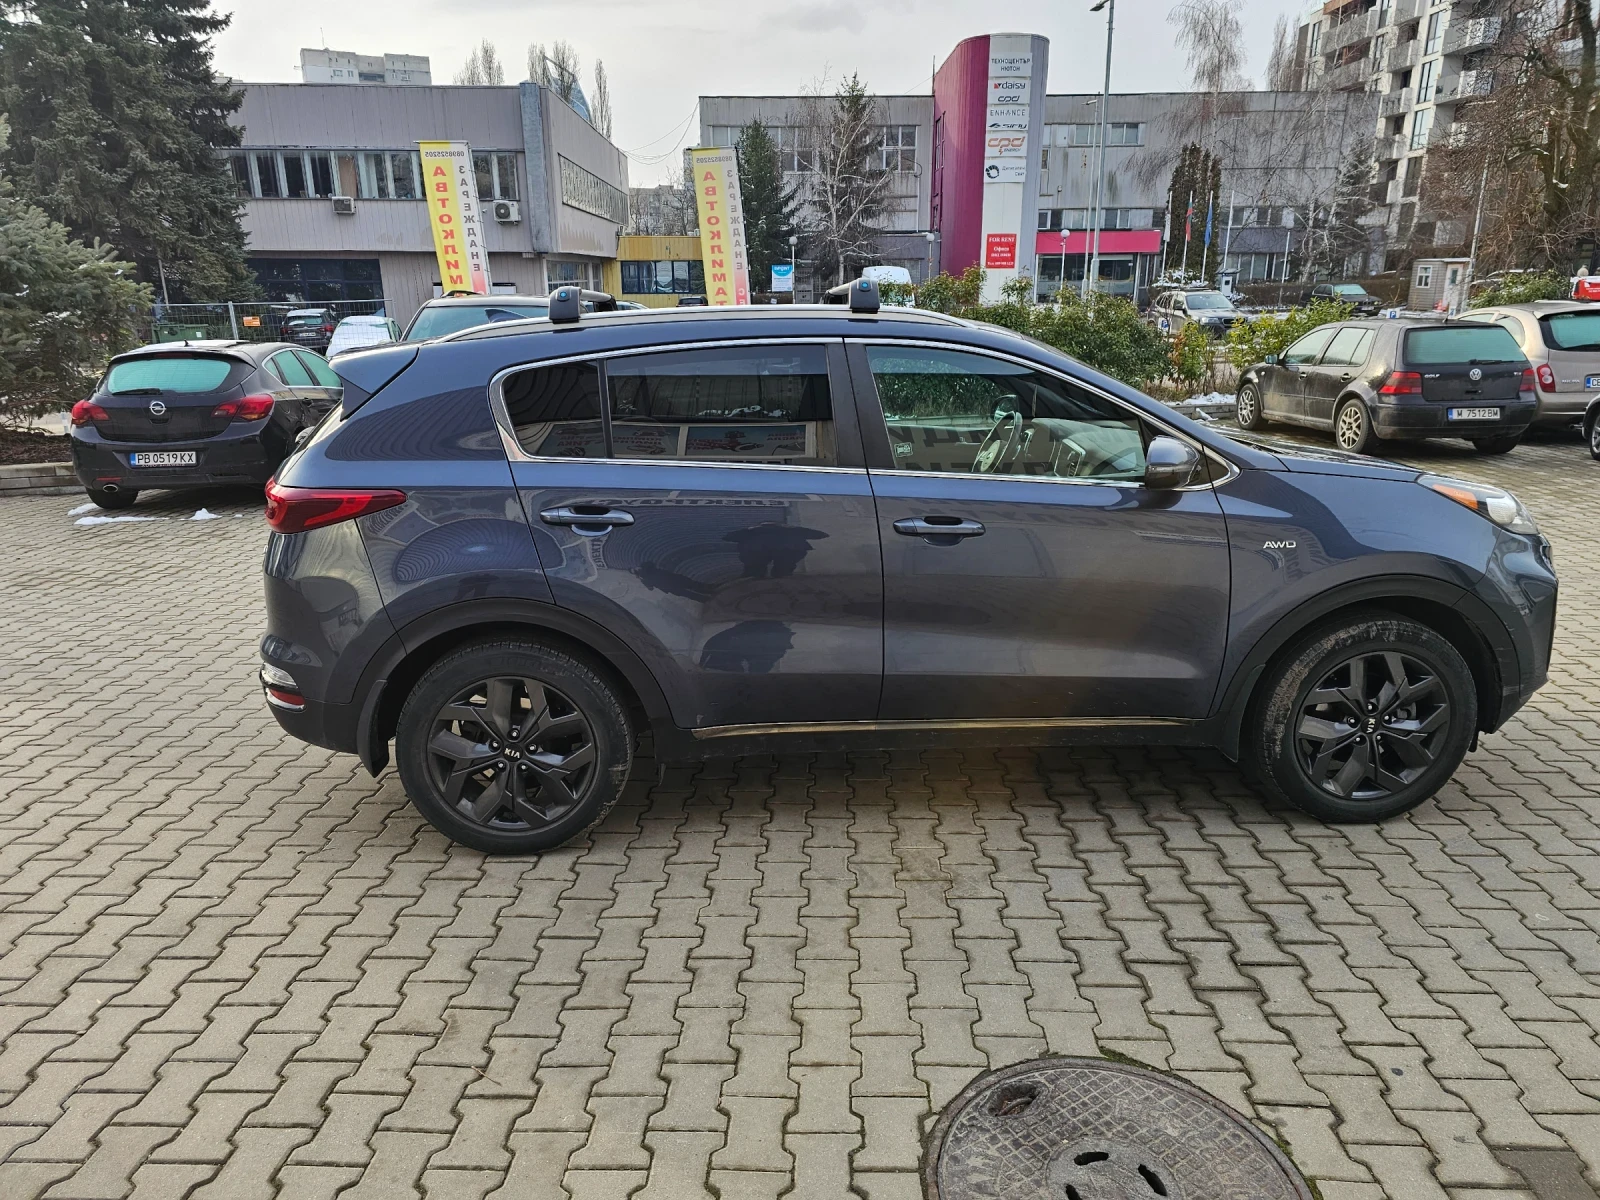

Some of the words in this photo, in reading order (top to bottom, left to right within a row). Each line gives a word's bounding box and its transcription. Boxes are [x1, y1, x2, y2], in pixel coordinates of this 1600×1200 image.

[1001, 81, 1025, 89] daisy
[1263, 541, 1297, 549] AWD
[1366, 718, 1376, 733] KIA
[504, 747, 520, 759] KIA
